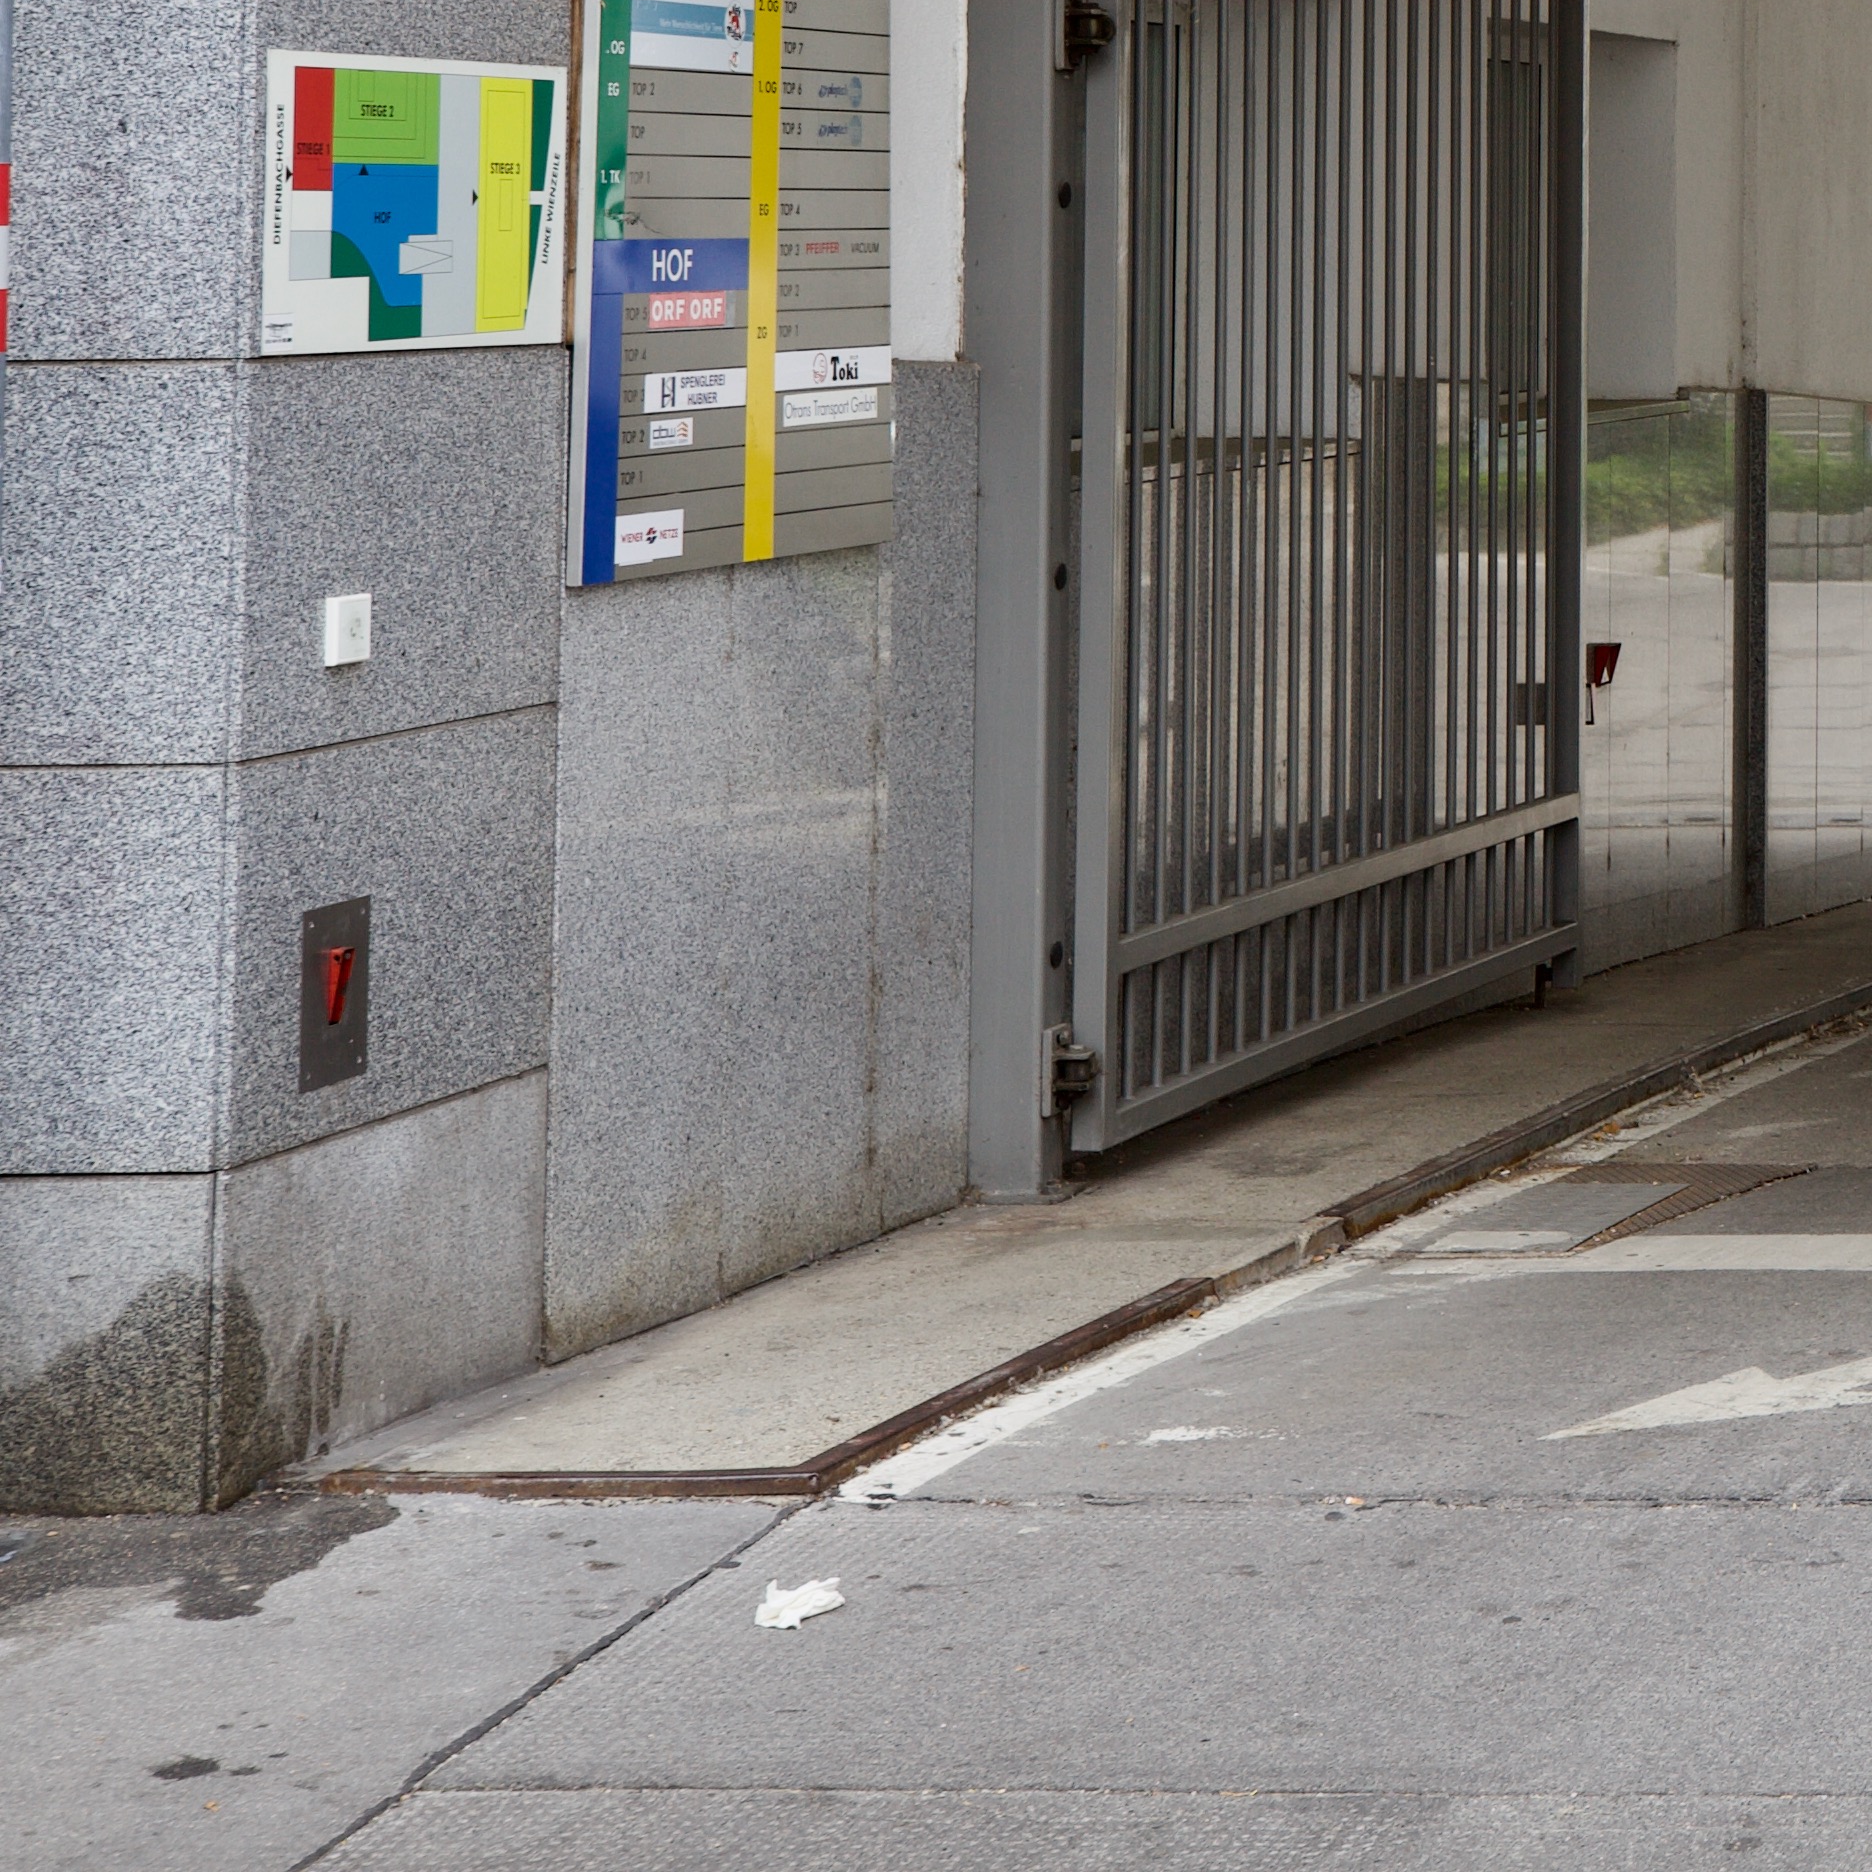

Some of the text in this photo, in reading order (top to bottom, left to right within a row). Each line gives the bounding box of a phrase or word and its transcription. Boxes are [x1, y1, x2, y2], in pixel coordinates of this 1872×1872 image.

[785, 1, 797, 13] TOP
[784, 41, 797, 54] TOP
[608, 82, 620, 97] EG
[633, 82, 647, 96] TOP
[783, 82, 796, 94] TOP
[361, 104, 395, 118] STIEGE 2
[631, 126, 645, 139] TOP
[782, 122, 795, 135] TOP
[297, 142, 324, 156] STIEGE
[273, 104, 286, 245] DIEFENBACHGASSE
[490, 162, 514, 174] STIEGE
[541, 152, 561, 265] LINKE WIENZEILE
[780, 203, 794, 216] TOP
[374, 211, 391, 224] HOF
[652, 248, 693, 282] HOF
[625, 307, 640, 321] TOP
[652, 297, 723, 321] ORF ORF
[624, 349, 639, 362] TOP
[830, 356, 859, 381] Toki
[680, 374, 726, 389] SPENGLEREI
[813, 400, 849, 419] Transport
[851, 394, 876, 413] GmbH
[622, 431, 636, 444] TOP
[621, 471, 635, 485] TOP
